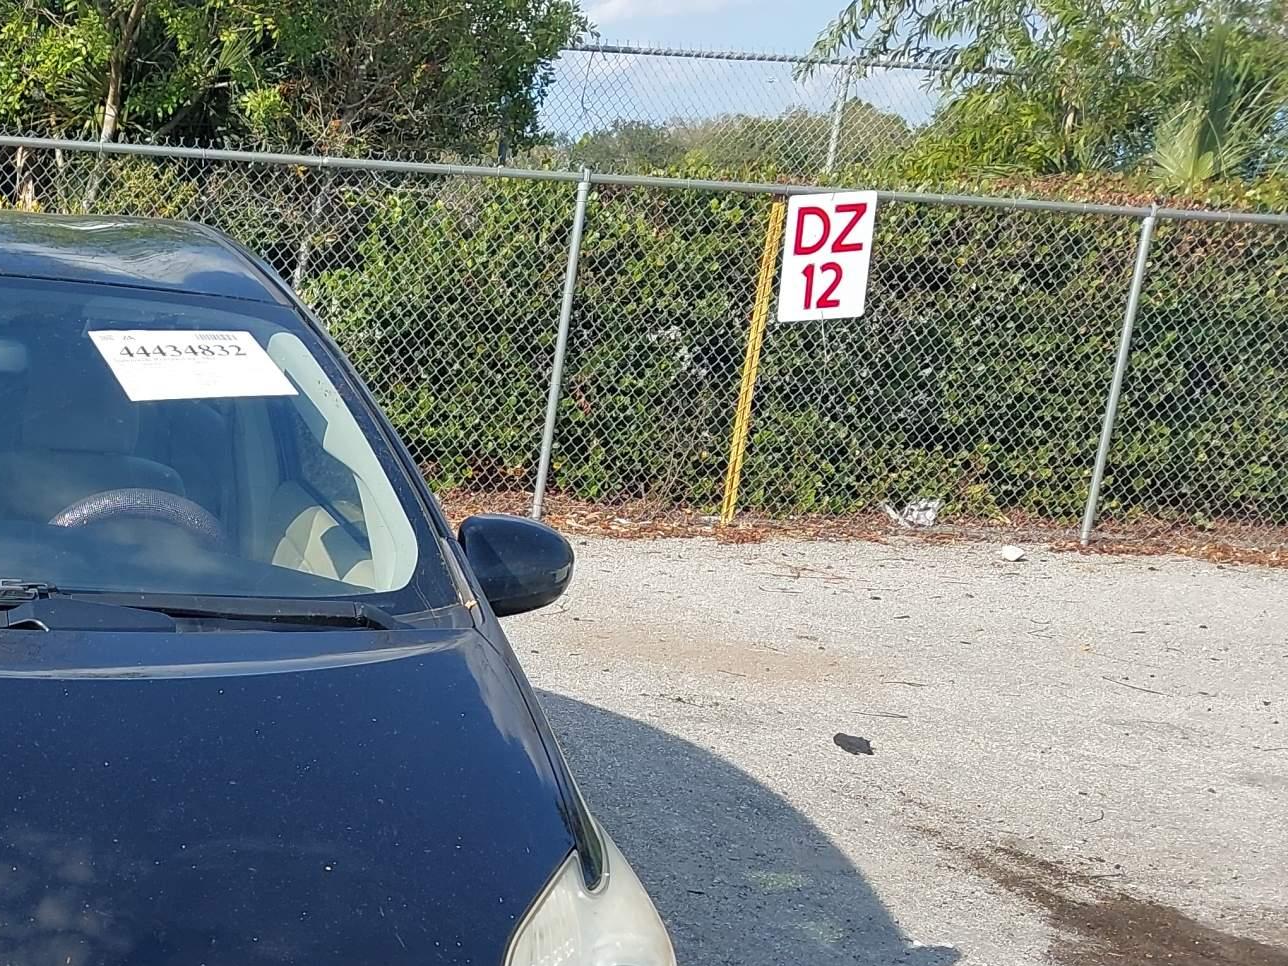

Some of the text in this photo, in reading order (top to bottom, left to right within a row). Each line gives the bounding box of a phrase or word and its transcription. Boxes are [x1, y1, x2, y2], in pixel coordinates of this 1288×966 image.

[793, 202, 868, 256] DZ
[801, 261, 843, 310] 12
[119, 344, 247, 358] 44434832
